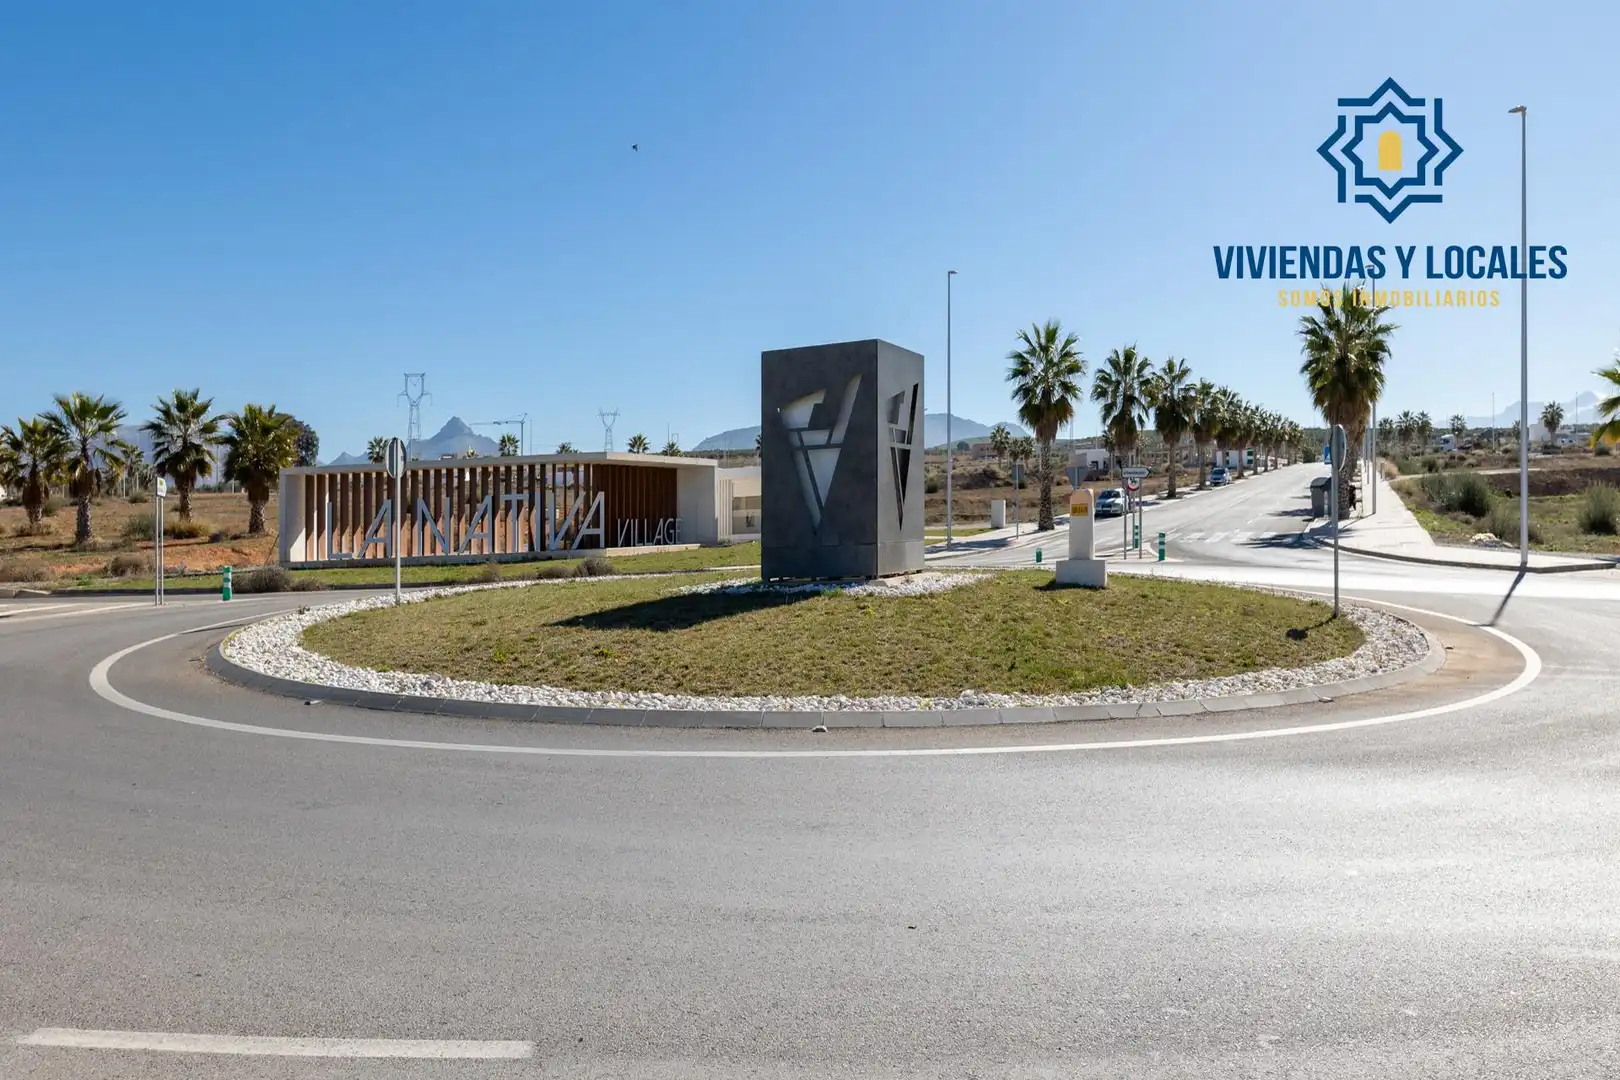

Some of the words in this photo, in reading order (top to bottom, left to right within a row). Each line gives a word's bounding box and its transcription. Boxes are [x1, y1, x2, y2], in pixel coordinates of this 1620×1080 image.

[327, 498, 392, 560] LA
[416, 491, 605, 557] NATIVA
[617, 517, 682, 548] VILLAGE
